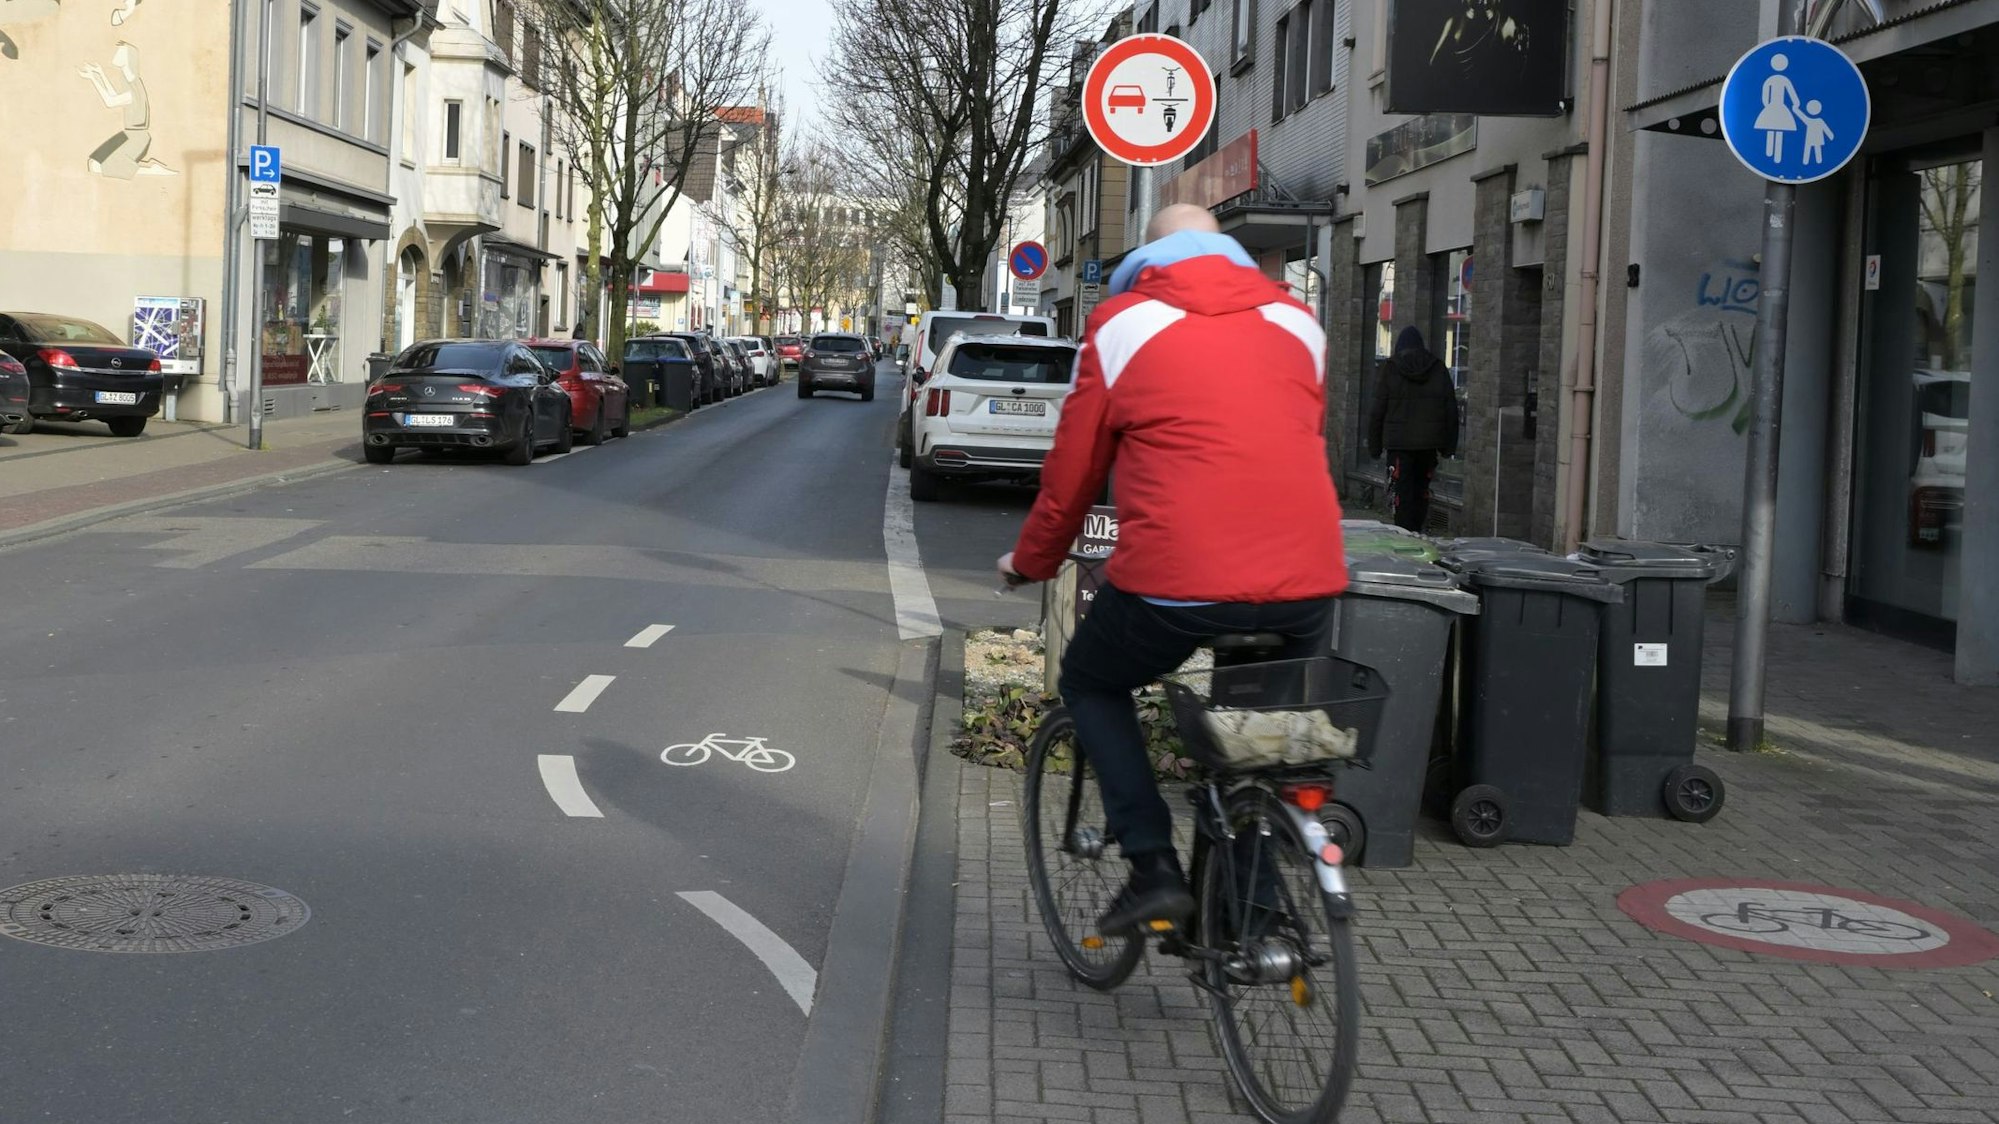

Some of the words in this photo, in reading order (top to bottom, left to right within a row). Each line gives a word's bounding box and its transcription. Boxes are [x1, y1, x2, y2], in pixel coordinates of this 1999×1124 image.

[255, 150, 271, 177] P
[1087, 263, 1097, 280] P
[996, 403, 1006, 411] GL
[1011, 403, 1023, 412] CA
[1024, 404, 1044, 413] 1000
[425, 416, 436, 424] LS
[438, 416, 453, 424] 176
